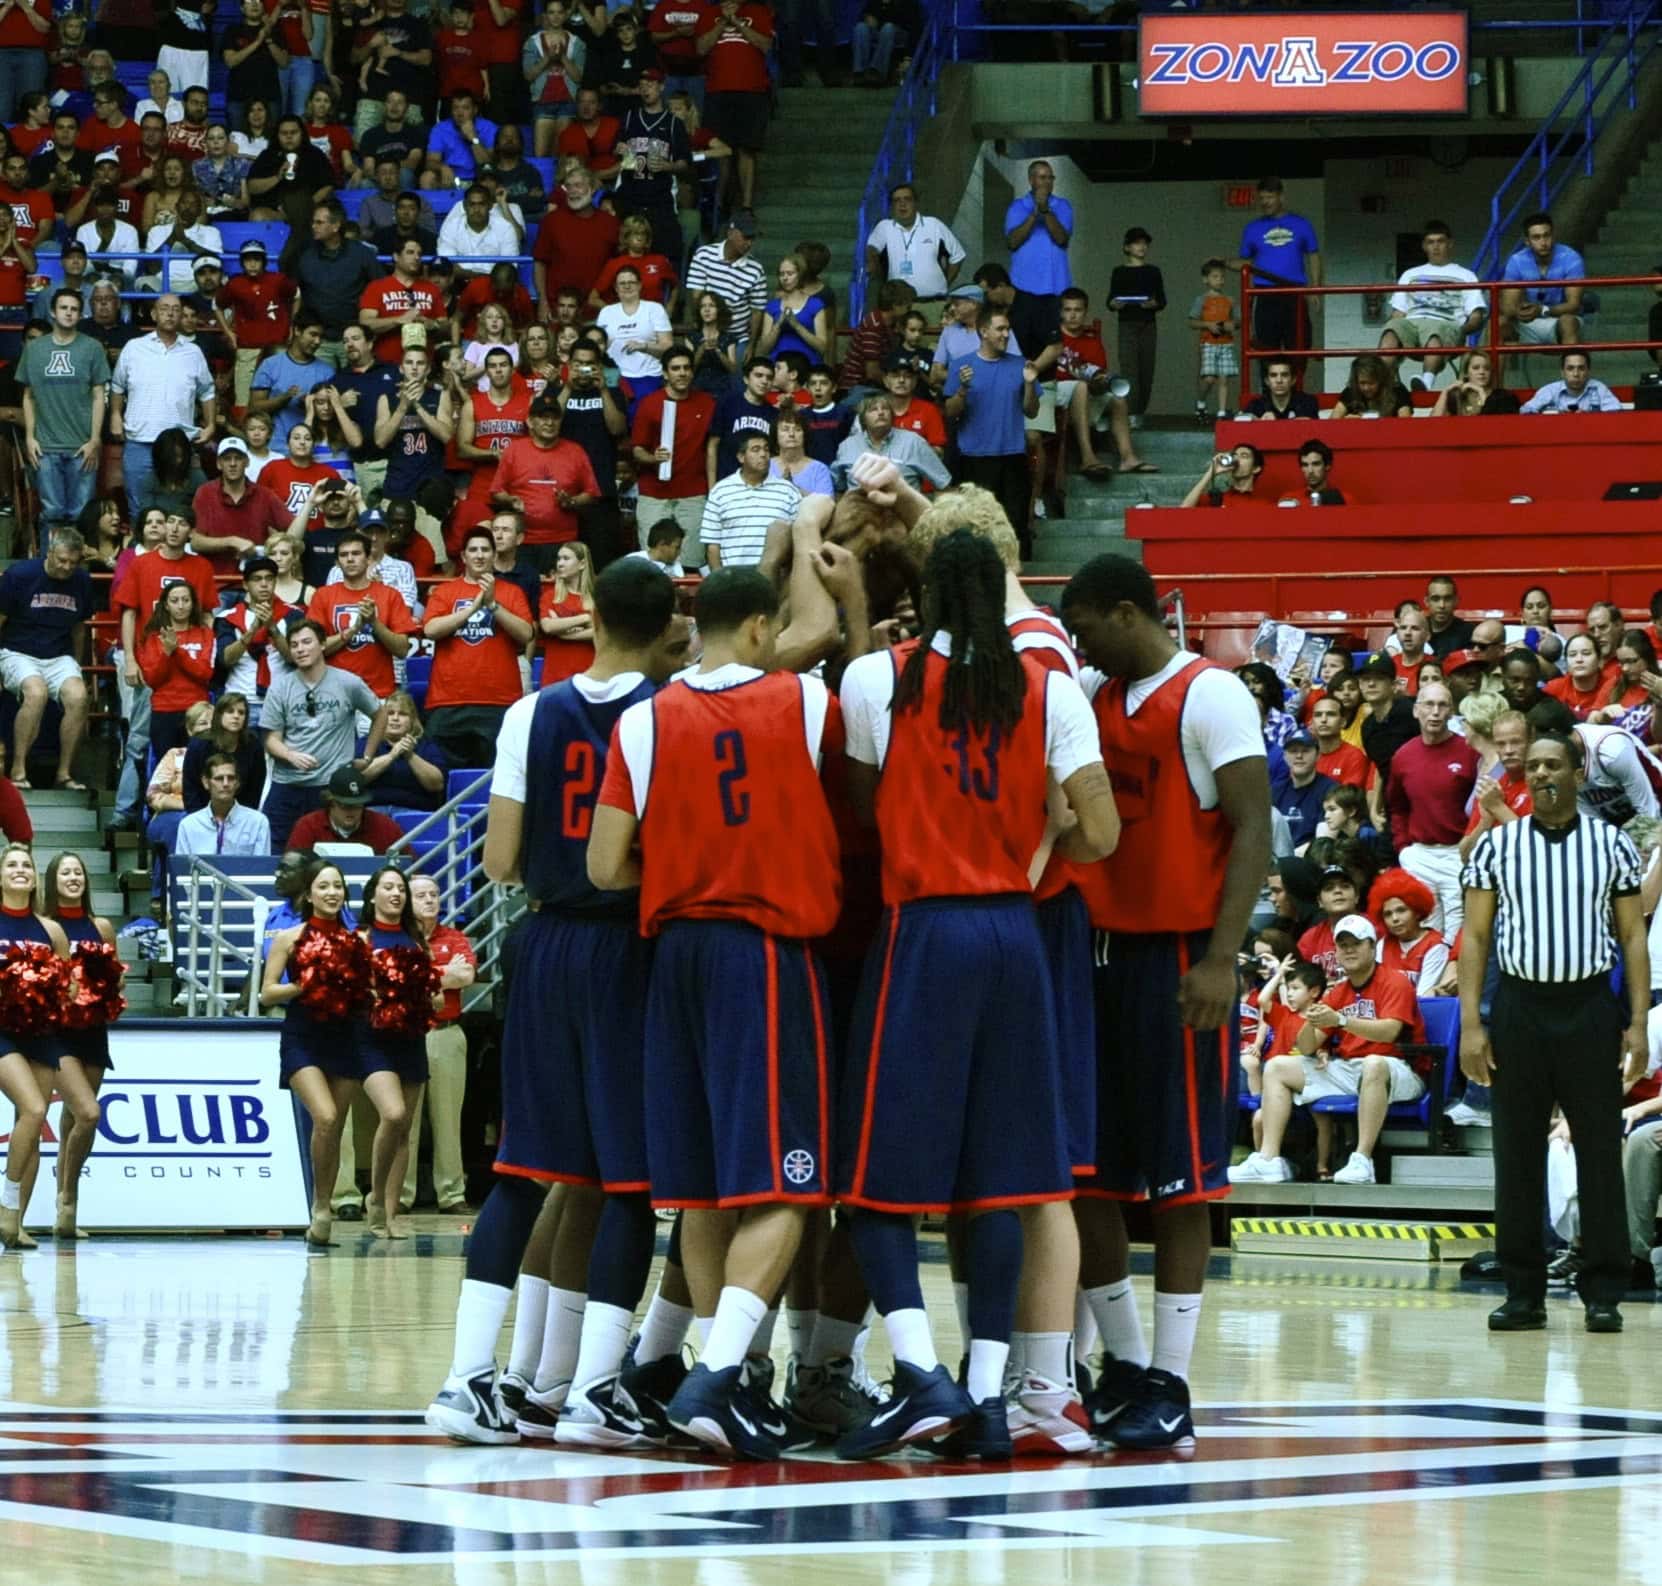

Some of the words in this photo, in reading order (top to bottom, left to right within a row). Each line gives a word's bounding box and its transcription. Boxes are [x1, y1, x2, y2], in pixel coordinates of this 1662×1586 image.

[382, 291, 433, 303] ARIZNA
[45, 350, 75, 376] A
[403, 433, 428, 456] 34
[714, 728, 750, 827] 2
[95, 1092, 270, 1145] CLUB
[123, 1166, 272, 1178] COUNTS
